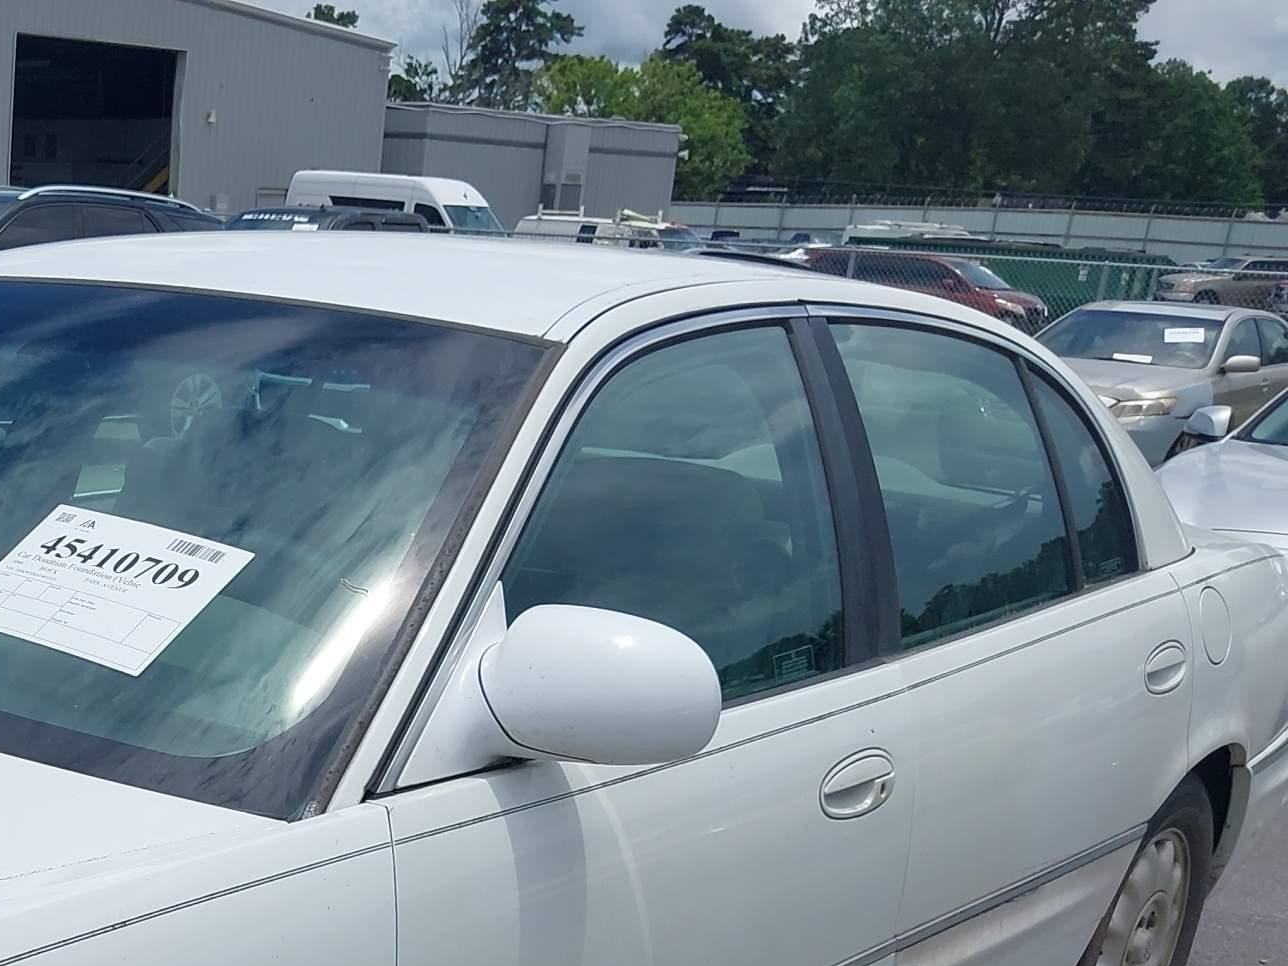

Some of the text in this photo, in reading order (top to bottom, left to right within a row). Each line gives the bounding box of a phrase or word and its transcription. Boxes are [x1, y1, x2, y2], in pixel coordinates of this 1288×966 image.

[17, 551, 33, 560] Car
[32, 554, 67, 569] Donation
[67, 563, 113, 581] Foundation
[39, 534, 201, 590] 45410709
